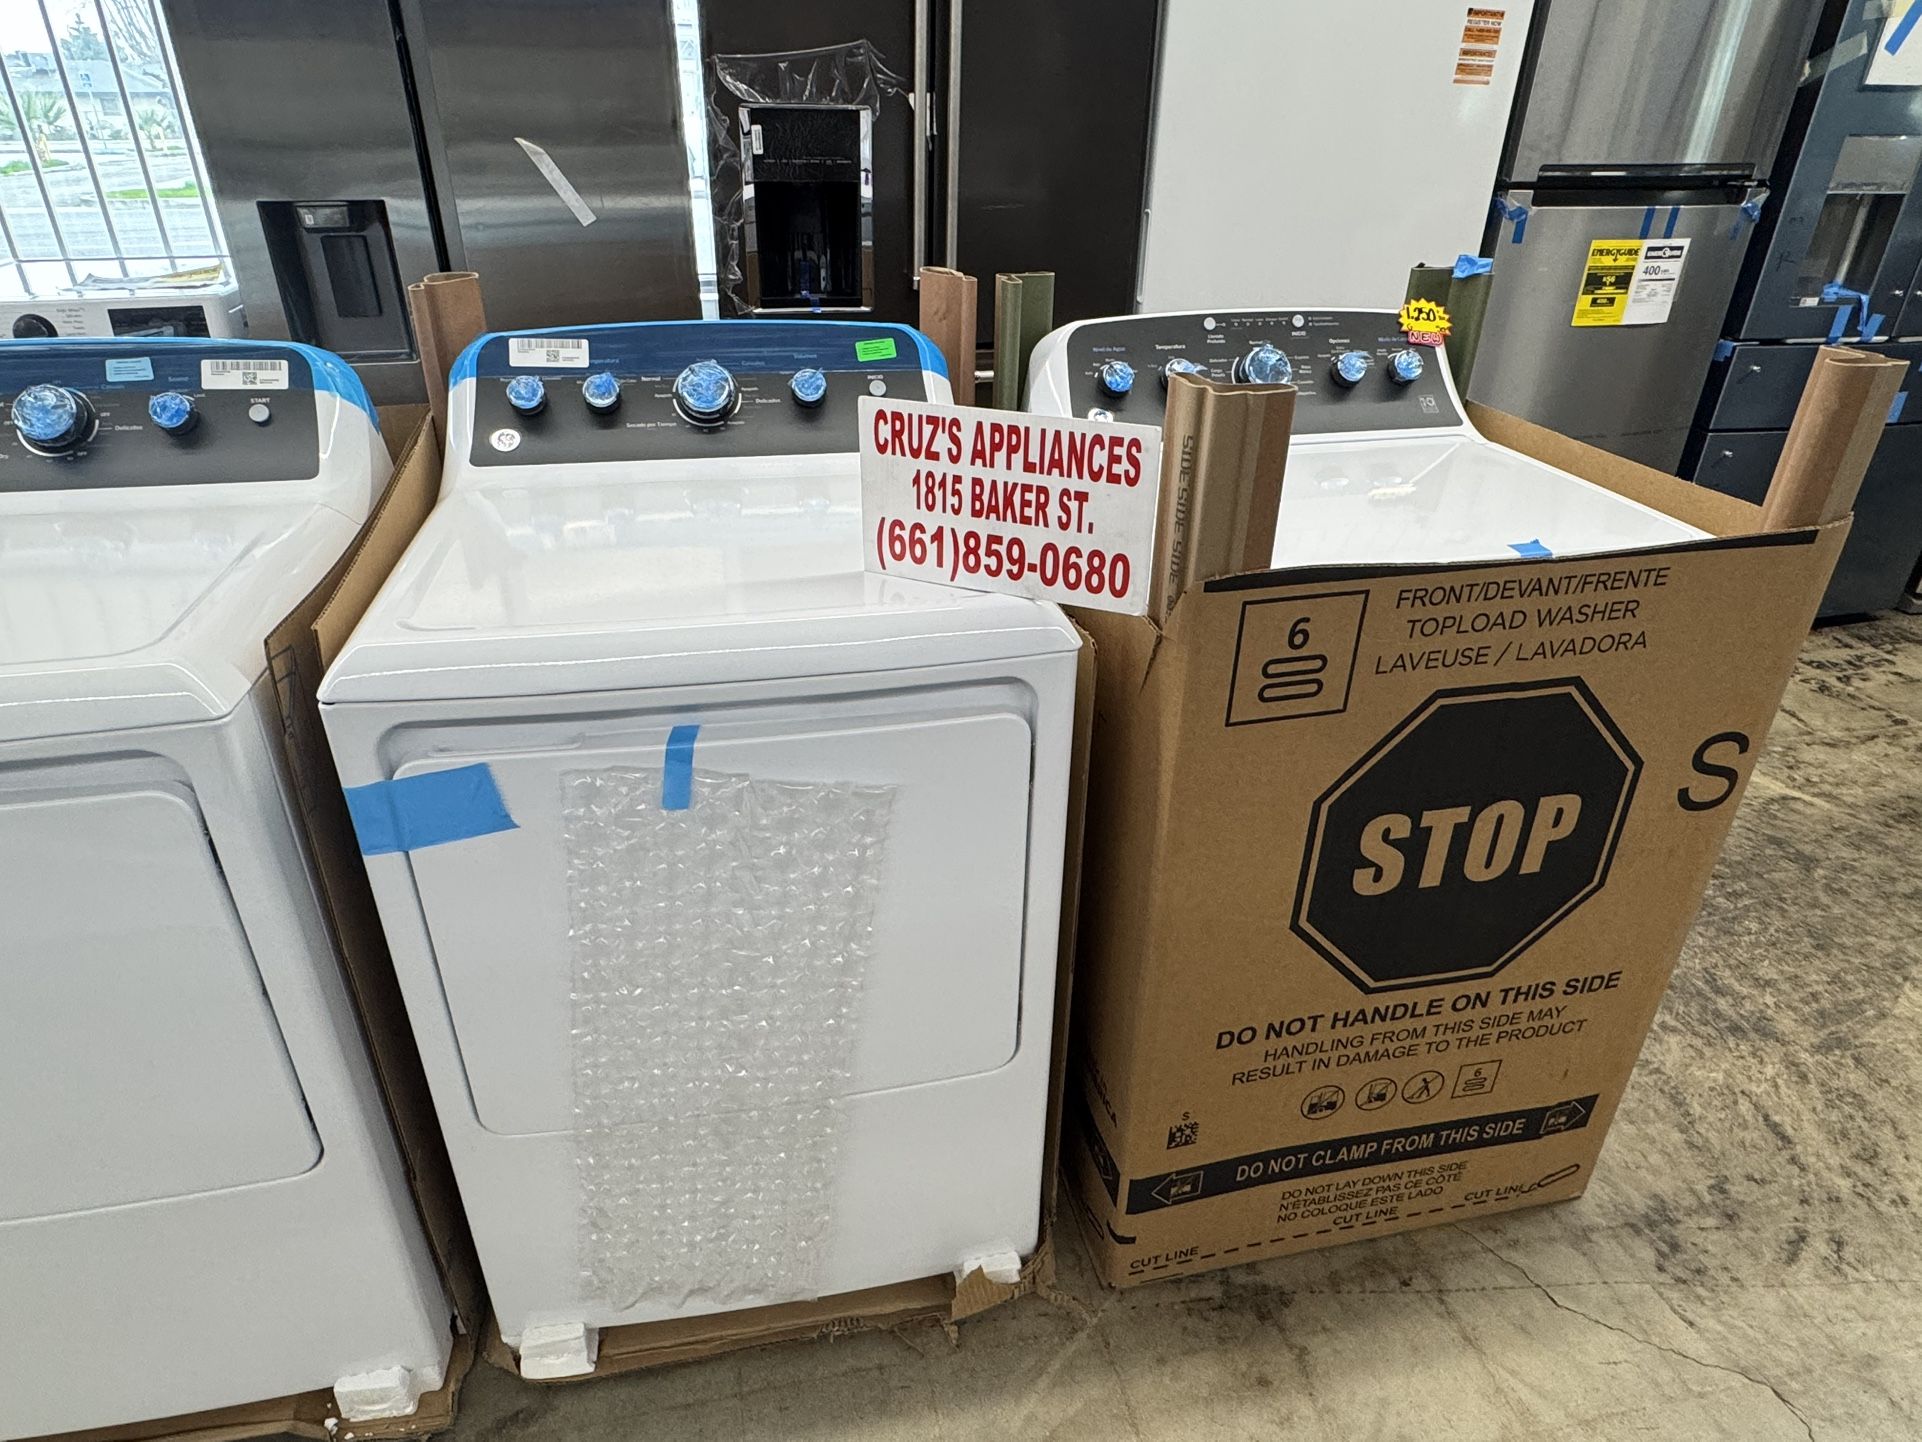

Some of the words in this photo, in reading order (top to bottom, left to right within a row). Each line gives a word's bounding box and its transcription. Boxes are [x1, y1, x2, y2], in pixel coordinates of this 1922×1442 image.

[1643, 265, 1661, 275] 400
[1410, 332, 1441, 343] NEW
[874, 408, 962, 465] CRUZ'S
[970, 420, 1142, 488] APPLIANCES
[1178, 435, 1194, 482] SIDE
[912, 469, 963, 516] 1815
[970, 477, 1050, 528] BAKER
[1057, 487, 1094, 534] ST.
[1174, 487, 1190, 536] SIDE
[876, 516, 1131, 598] (661)859-0680
[1169, 541, 1182, 584] SIDE
[1396, 567, 1671, 608] FRONT/DEVANT/FRENTE
[1287, 616, 1311, 650] 6
[1407, 610, 1527, 639] TOPLOAD
[1536, 600, 1640, 628] WASHER
[1375, 646, 1492, 675] LAVEUSE
[1494, 641, 1513, 666] /
[1516, 631, 1647, 661] LAVADORA
[1677, 731, 1750, 812] S
[1352, 793, 1582, 896] STOP
[1216, 1026, 1257, 1049] DO
[1264, 1014, 1325, 1040] NOT
[1330, 998, 1446, 1029] HANDLE
[1451, 991, 1491, 1012] ON
[1499, 981, 1556, 1005] THIS
[1562, 970, 1623, 996] SIDE
[1231, 1060, 1306, 1086] RESULT
[1311, 1056, 1331, 1071] IN
[1336, 1043, 1419, 1067] DAMAGE
[1425, 1040, 1450, 1054] TO
[1455, 1032, 1493, 1050] THE
[1496, 1019, 1588, 1044] PRODUCT
[1264, 1035, 1364, 1062] HANDLING
[1370, 1026, 1427, 1046] FROM
[1433, 1018, 1474, 1037] THIS
[1479, 1011, 1523, 1029] SIDE
[1526, 1005, 1568, 1023] MAY
[1474, 1068, 1482, 1077] 6
[1182, 1112, 1190, 1121] S
[1235, 1162, 1264, 1182] DO
[1268, 1153, 1309, 1174] NOT
[1312, 1142, 1378, 1167] CLAMP
[1380, 1134, 1435, 1156] FROM
[1439, 1126, 1479, 1146] THIS
[1482, 1118, 1527, 1139] SIDE
[1282, 1190, 1303, 1200] DO
[1304, 1184, 1335, 1196] NOT
[1335, 1179, 1361, 1190] LAY
[1361, 1171, 1404, 1186] DOWN
[1407, 1167, 1435, 1179] THIS
[1437, 1160, 1468, 1174] SIDE
[1375, 1183, 1401, 1195] PAS
[1404, 1178, 1423, 1190] CE
[1464, 1189, 1492, 1201] CUT
[1276, 1212, 1298, 1224] NO
[1301, 1199, 1368, 1219] COLOQUE
[1370, 1195, 1404, 1208] ESTE
[1407, 1185, 1444, 1200] LADO
[1333, 1213, 1362, 1226] CUT
[1365, 1206, 1399, 1220] LINE
[1130, 1255, 1161, 1269] CUT
[1165, 1246, 1199, 1262] LINE
